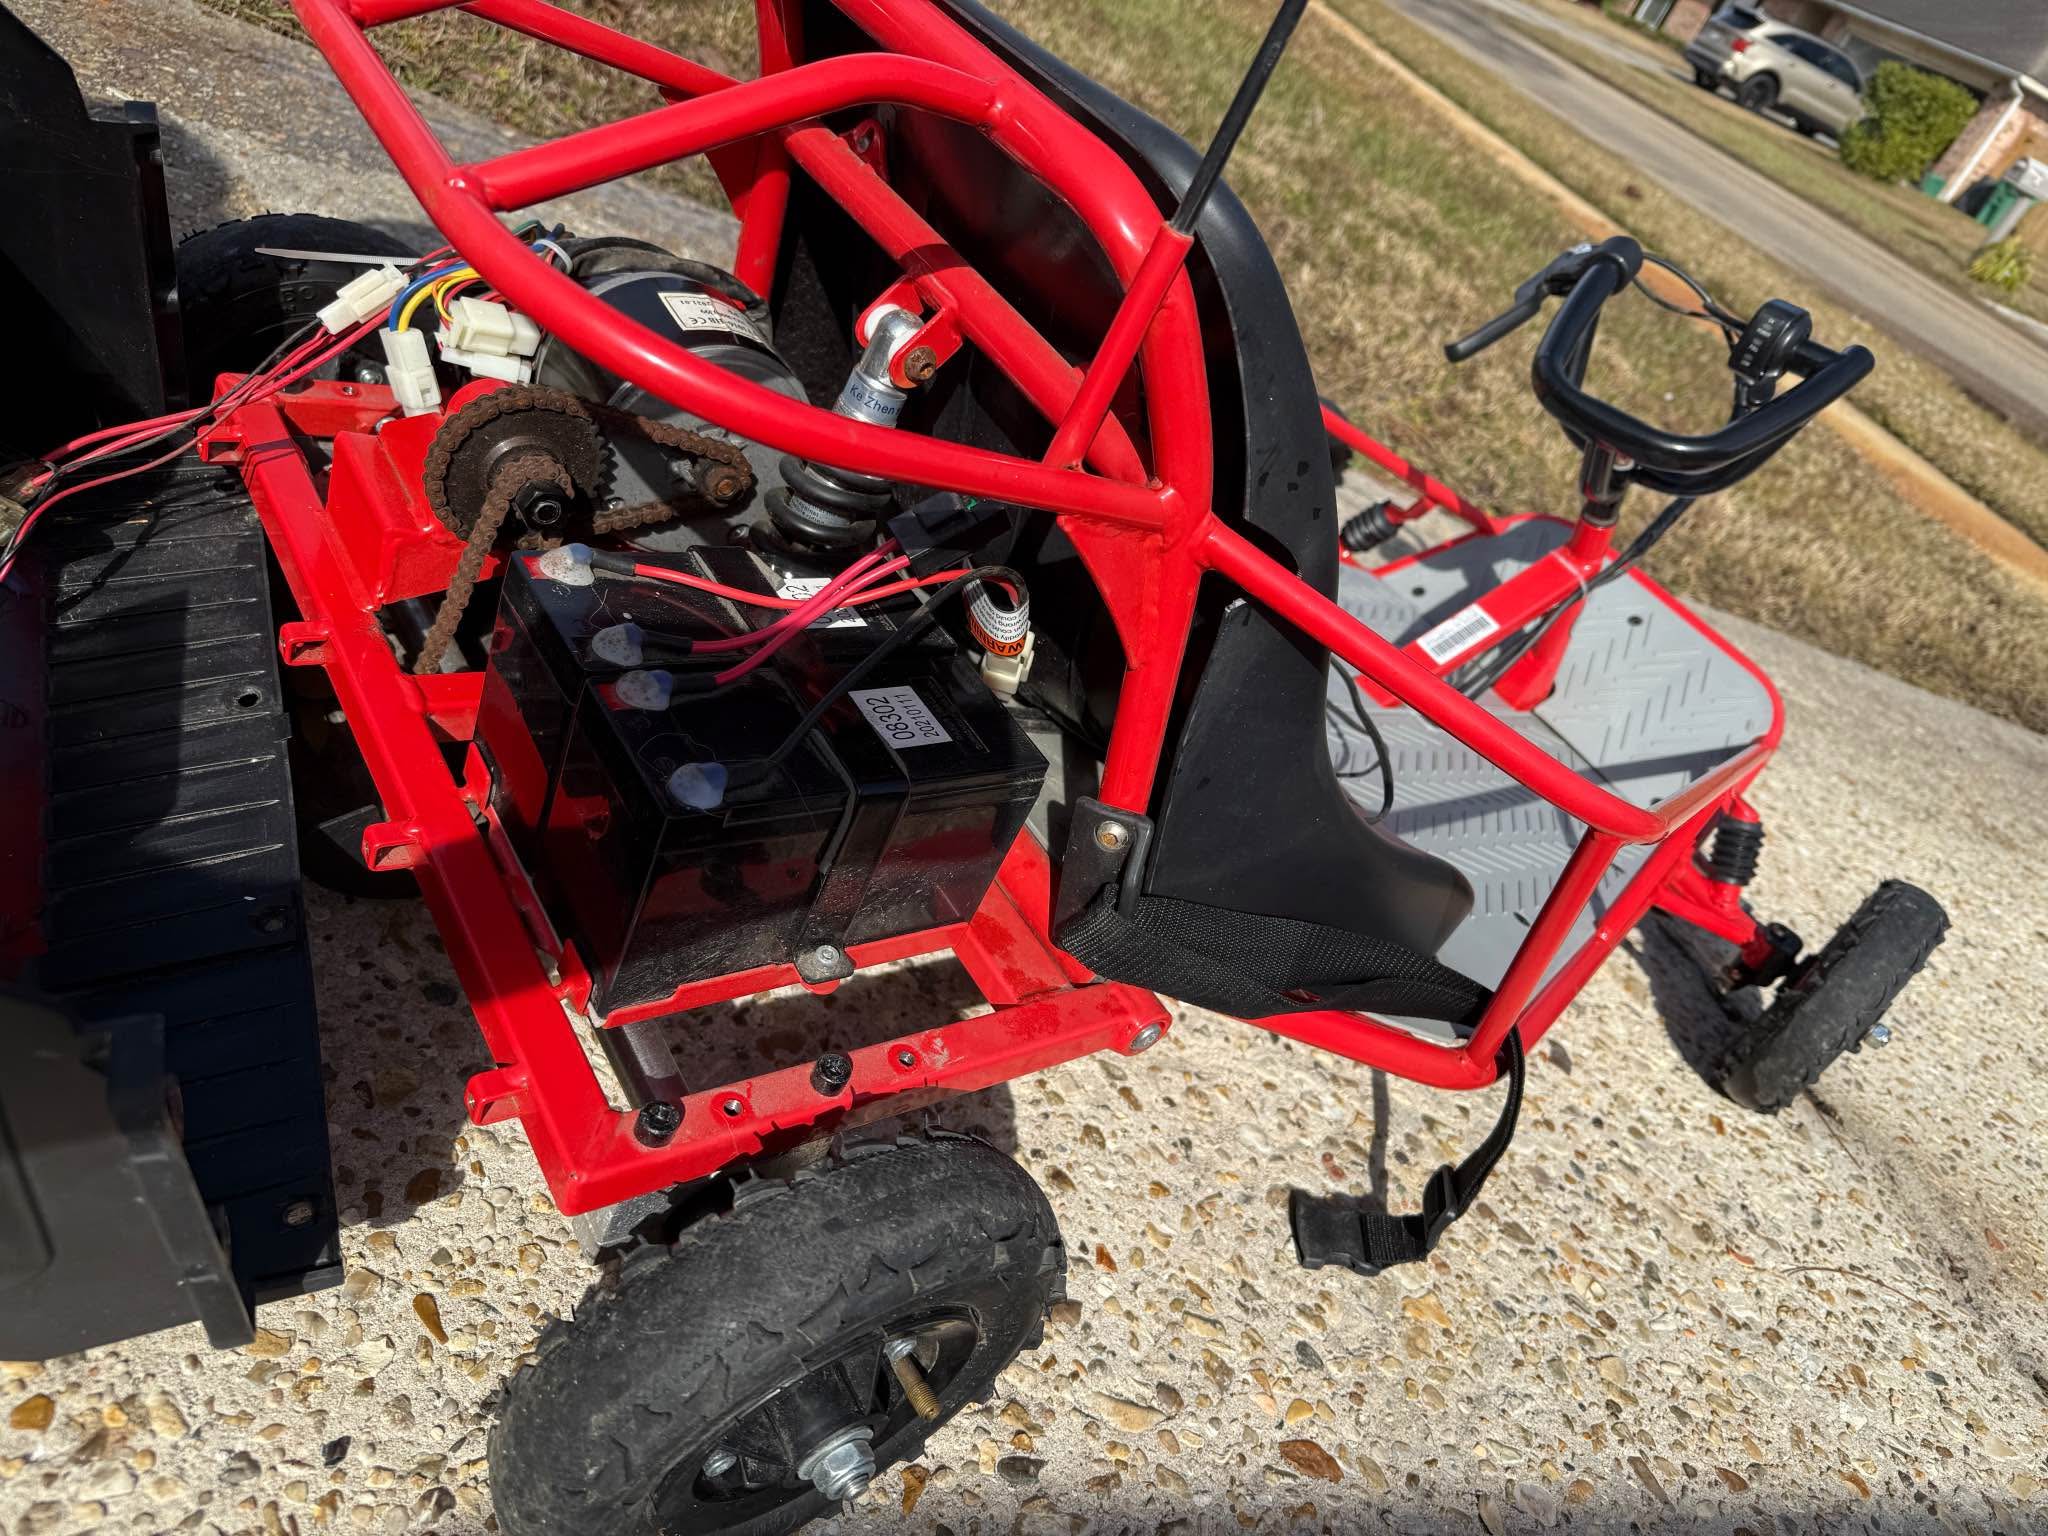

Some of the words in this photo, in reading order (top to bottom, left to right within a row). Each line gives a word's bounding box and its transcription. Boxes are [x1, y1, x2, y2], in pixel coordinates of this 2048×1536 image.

[849, 383, 863, 401] Ke
[864, 395, 899, 416] Zhen
[866, 696, 916, 740] 08302
[894, 694, 940, 738] 20210111
